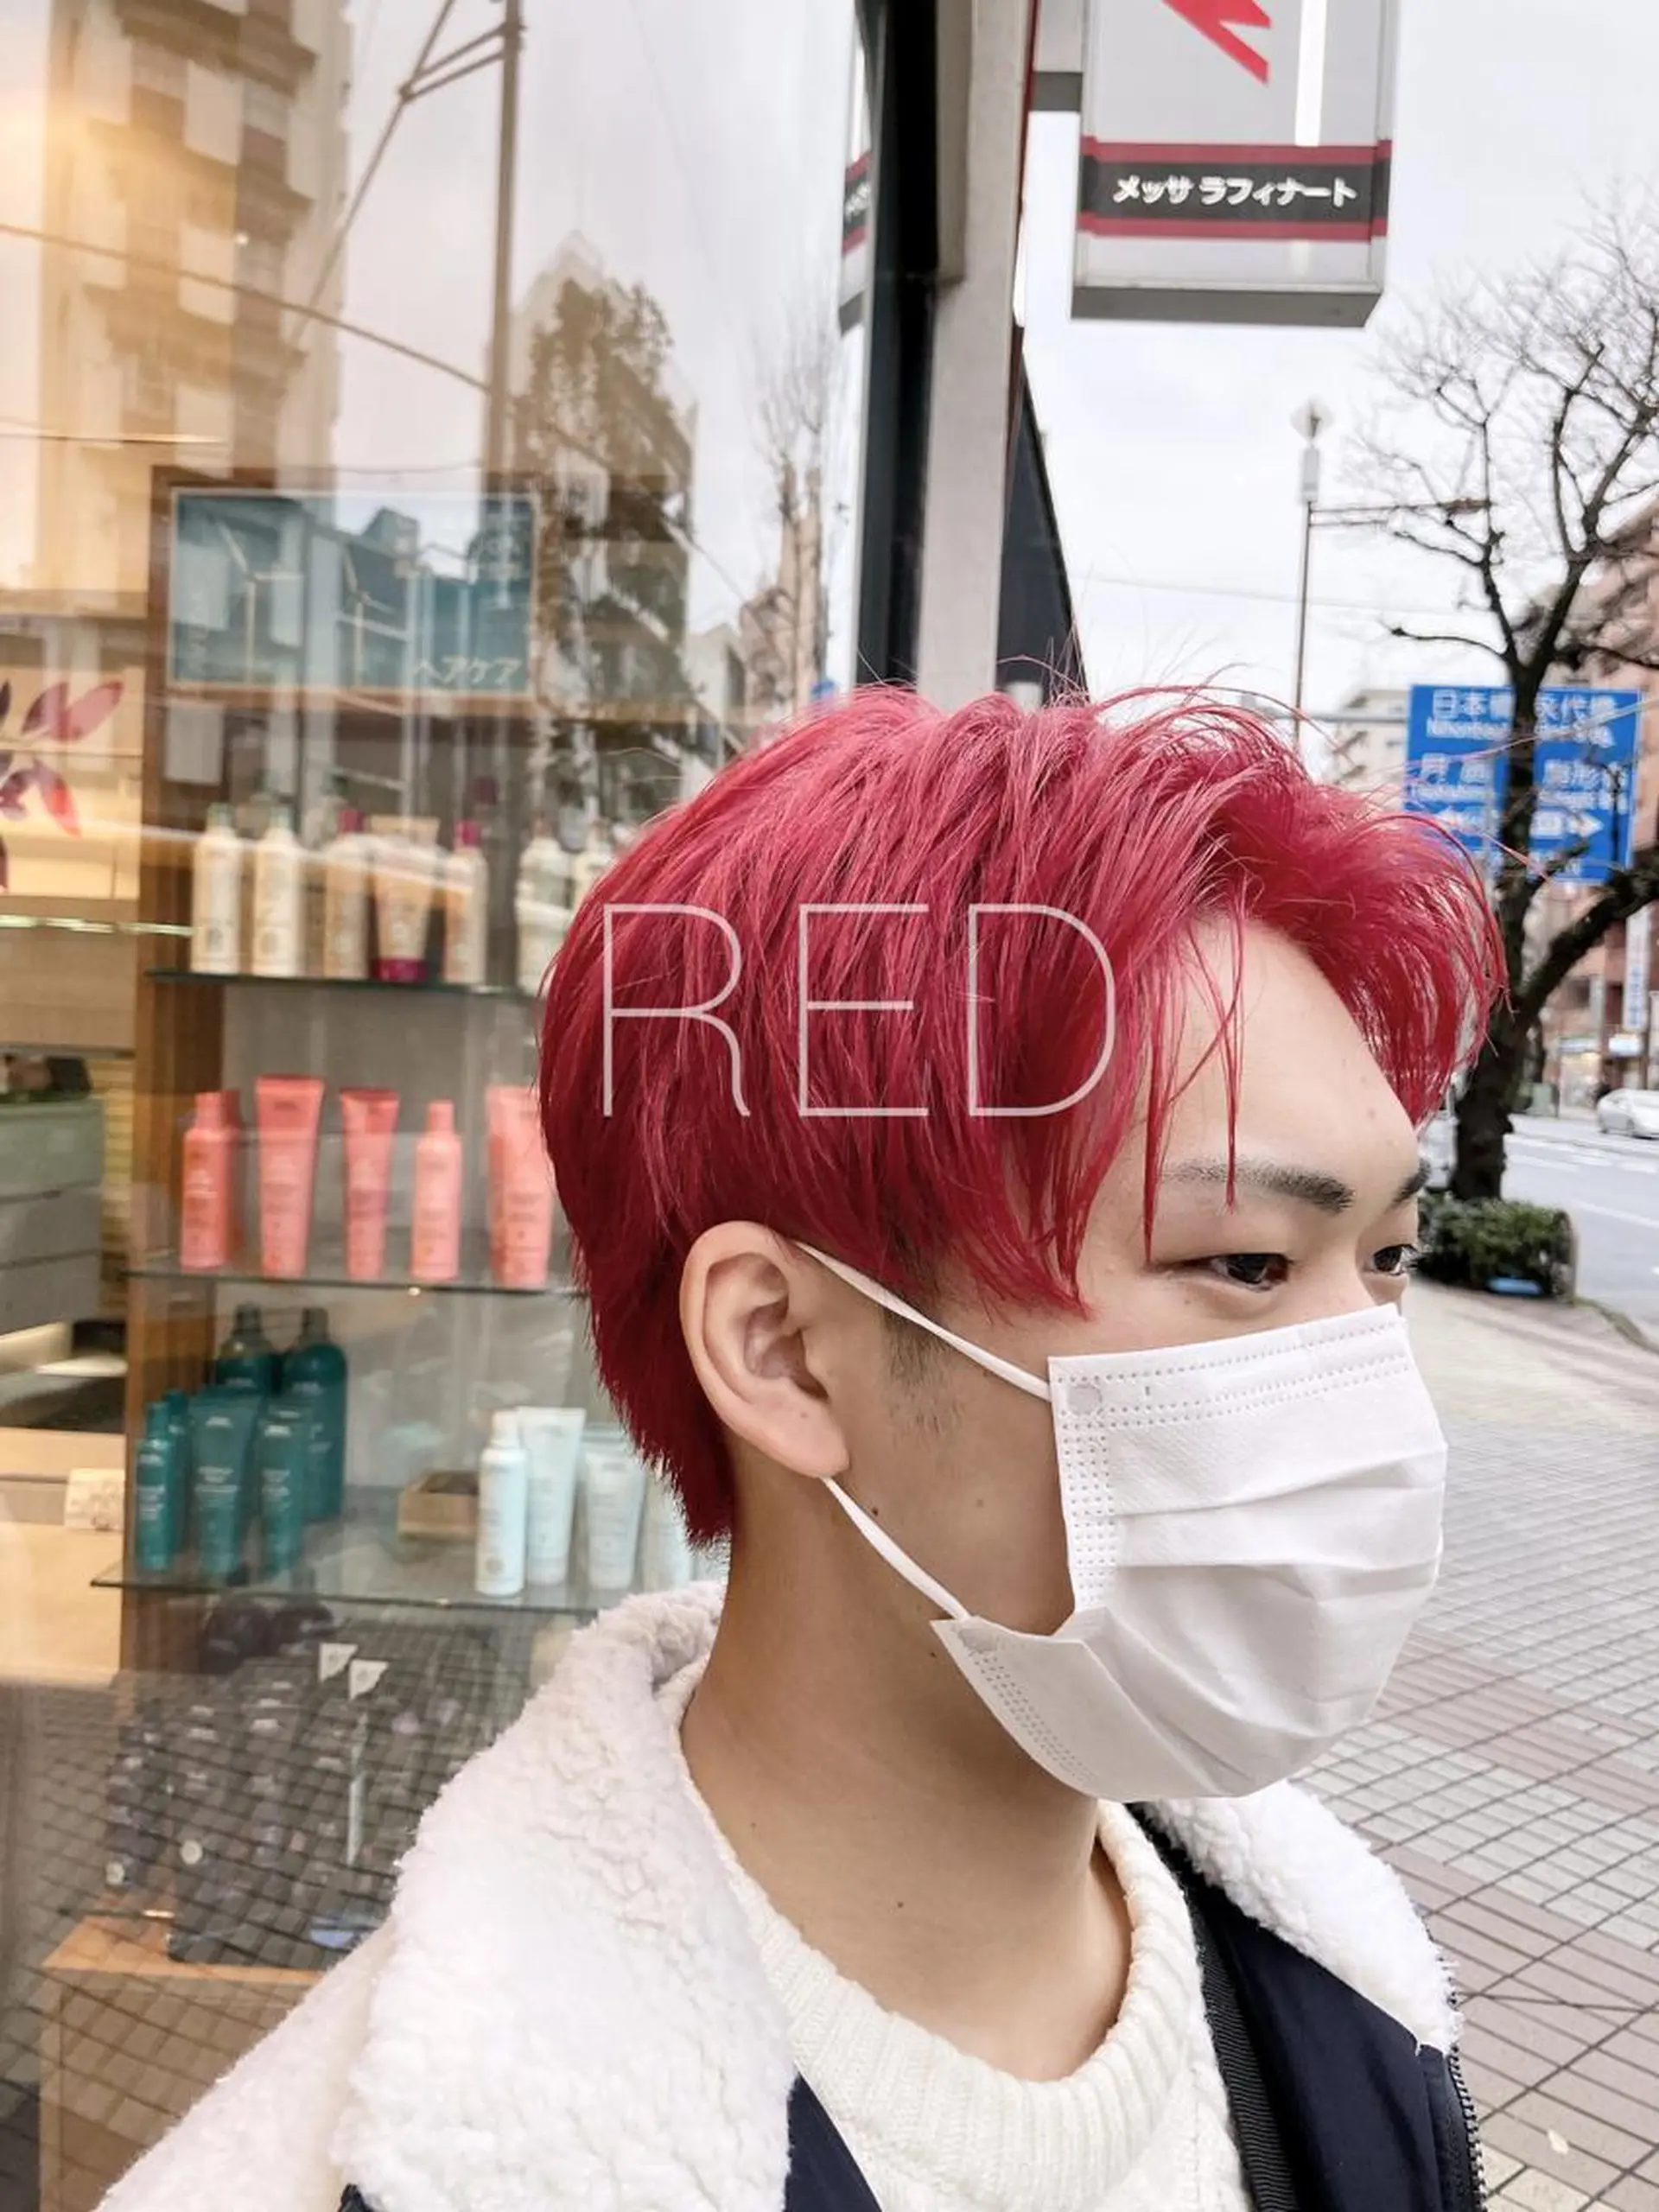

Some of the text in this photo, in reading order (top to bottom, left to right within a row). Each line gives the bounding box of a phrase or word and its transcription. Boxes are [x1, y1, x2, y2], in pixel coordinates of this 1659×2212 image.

[1113, 175, 1357, 207] メッサ ラフィナート
